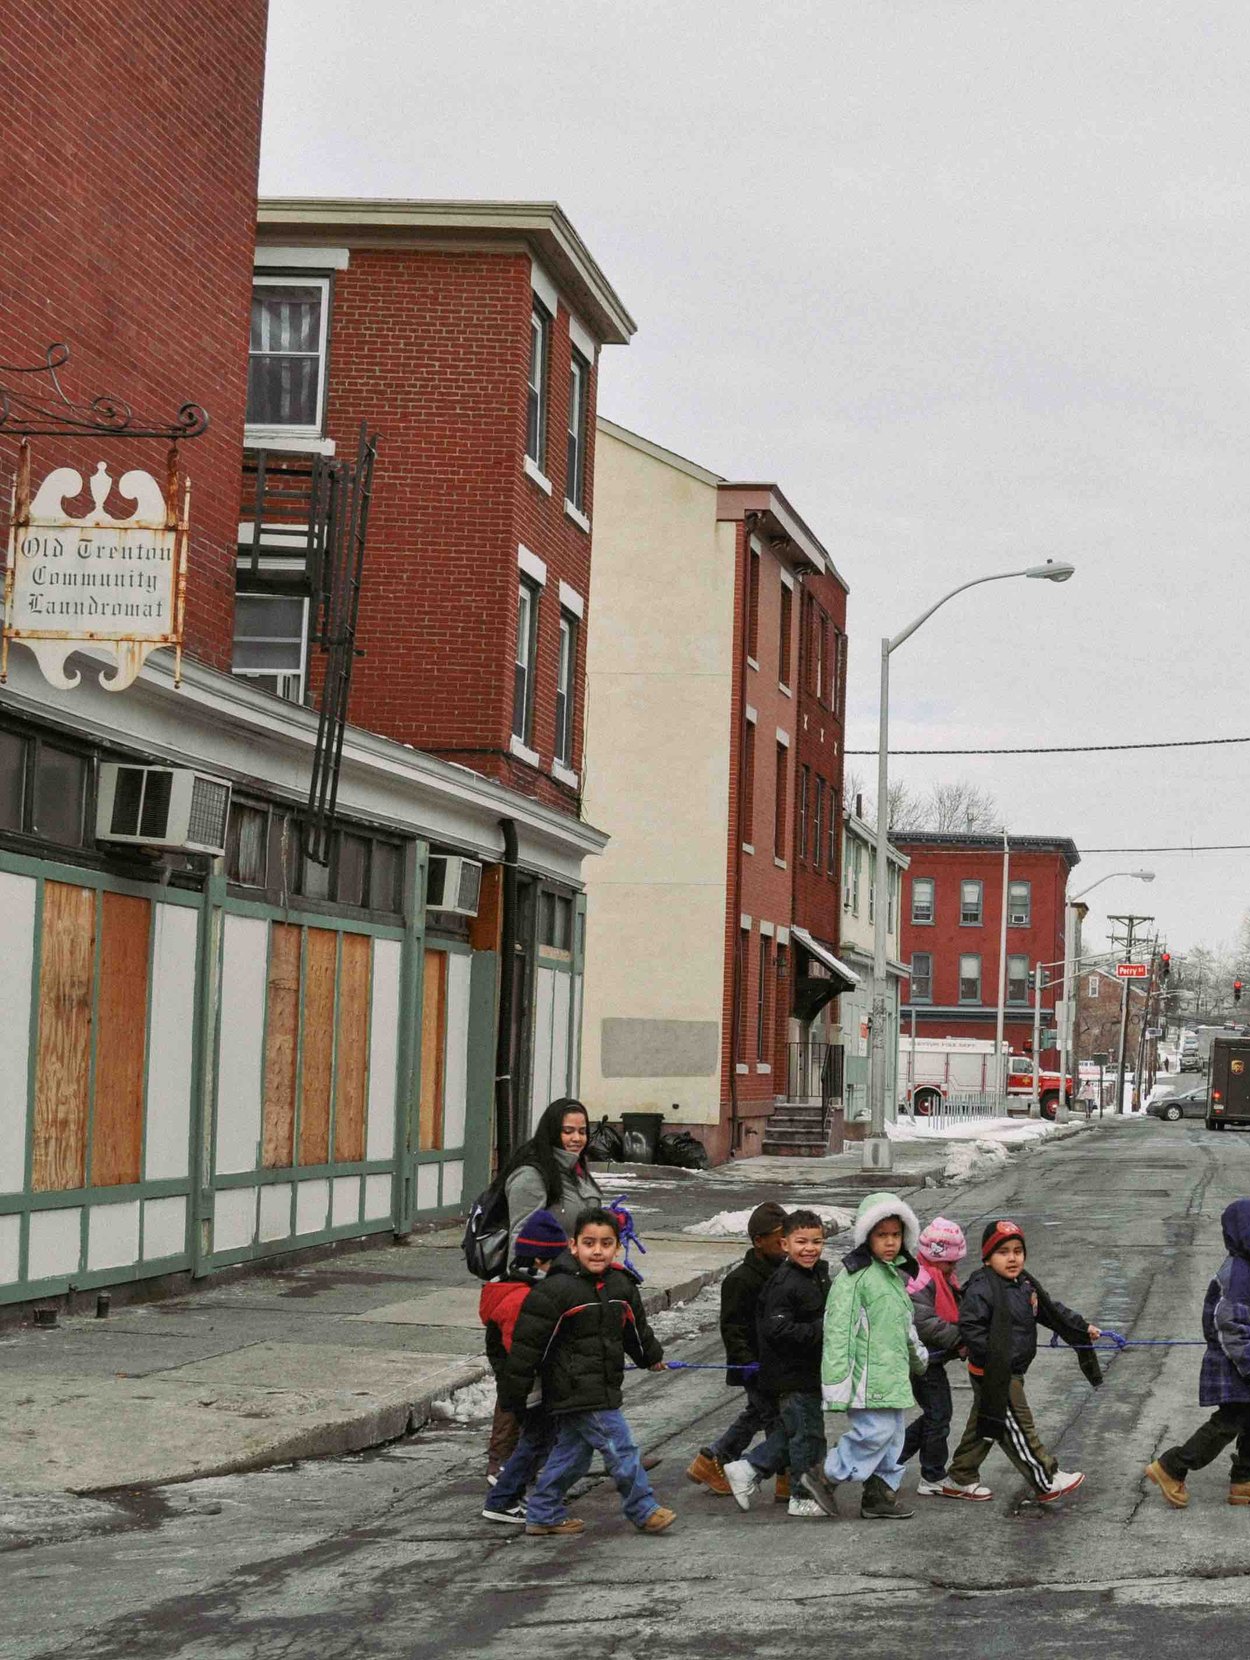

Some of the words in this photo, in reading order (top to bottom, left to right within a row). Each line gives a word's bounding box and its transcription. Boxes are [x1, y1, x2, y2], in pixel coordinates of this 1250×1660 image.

[21, 536, 64, 559] Old
[77, 538, 172, 561] Trenton
[32, 565, 158, 594] Community
[29, 593, 164, 617] Laundromat
[1119, 966, 1137, 976] Perry
